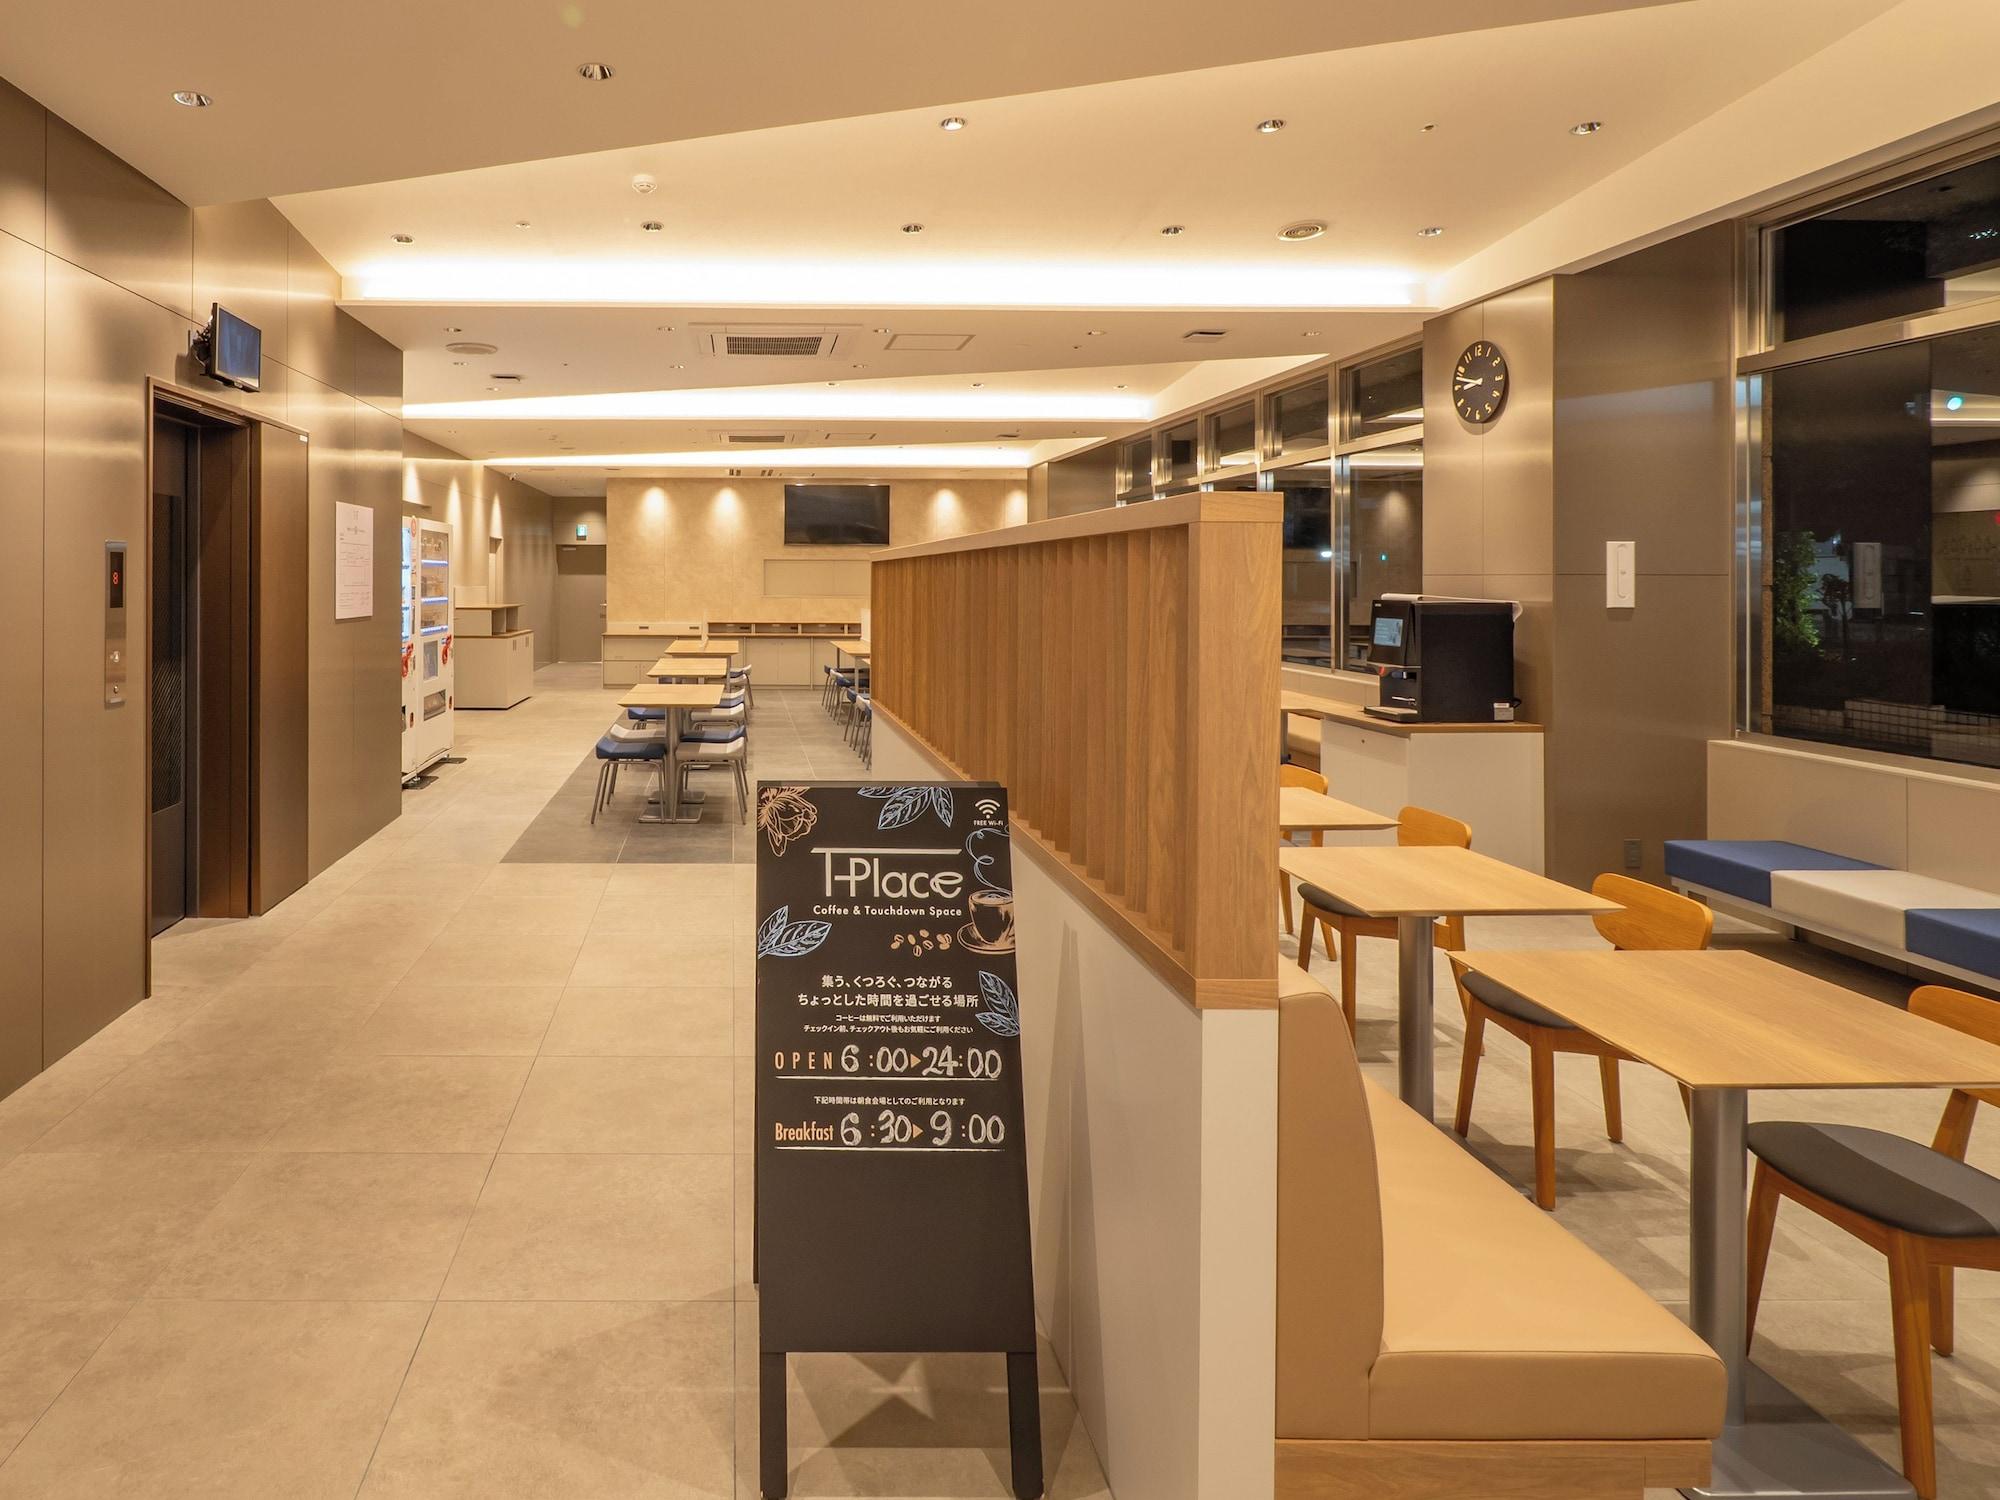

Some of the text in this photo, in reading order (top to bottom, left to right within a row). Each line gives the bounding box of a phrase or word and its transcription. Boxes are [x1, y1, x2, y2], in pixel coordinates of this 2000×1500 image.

[1475, 344, 1482, 357] 12
[1464, 352, 1472, 364] 11
[1492, 357, 1500, 367] 2
[1465, 407, 1471, 417] 7
[1485, 402, 1492, 413] 5
[813, 904, 962, 918] Coffee & Touchdown Space
[821, 974, 953, 989] 集う、くつろぐ、つながる
[797, 993, 979, 1008] ちょっとした時間を過ごせる場所
[835, 1014, 941, 1023] コーヒーは無料でご利用いただけます
[774, 1051, 833, 1070] OPEN
[921, 1044, 1003, 1079] 24:00
[813, 1095, 966, 1106] 下記時間帯は朝食会場としてのご利用となります
[775, 1120, 834, 1141] Breakfast
